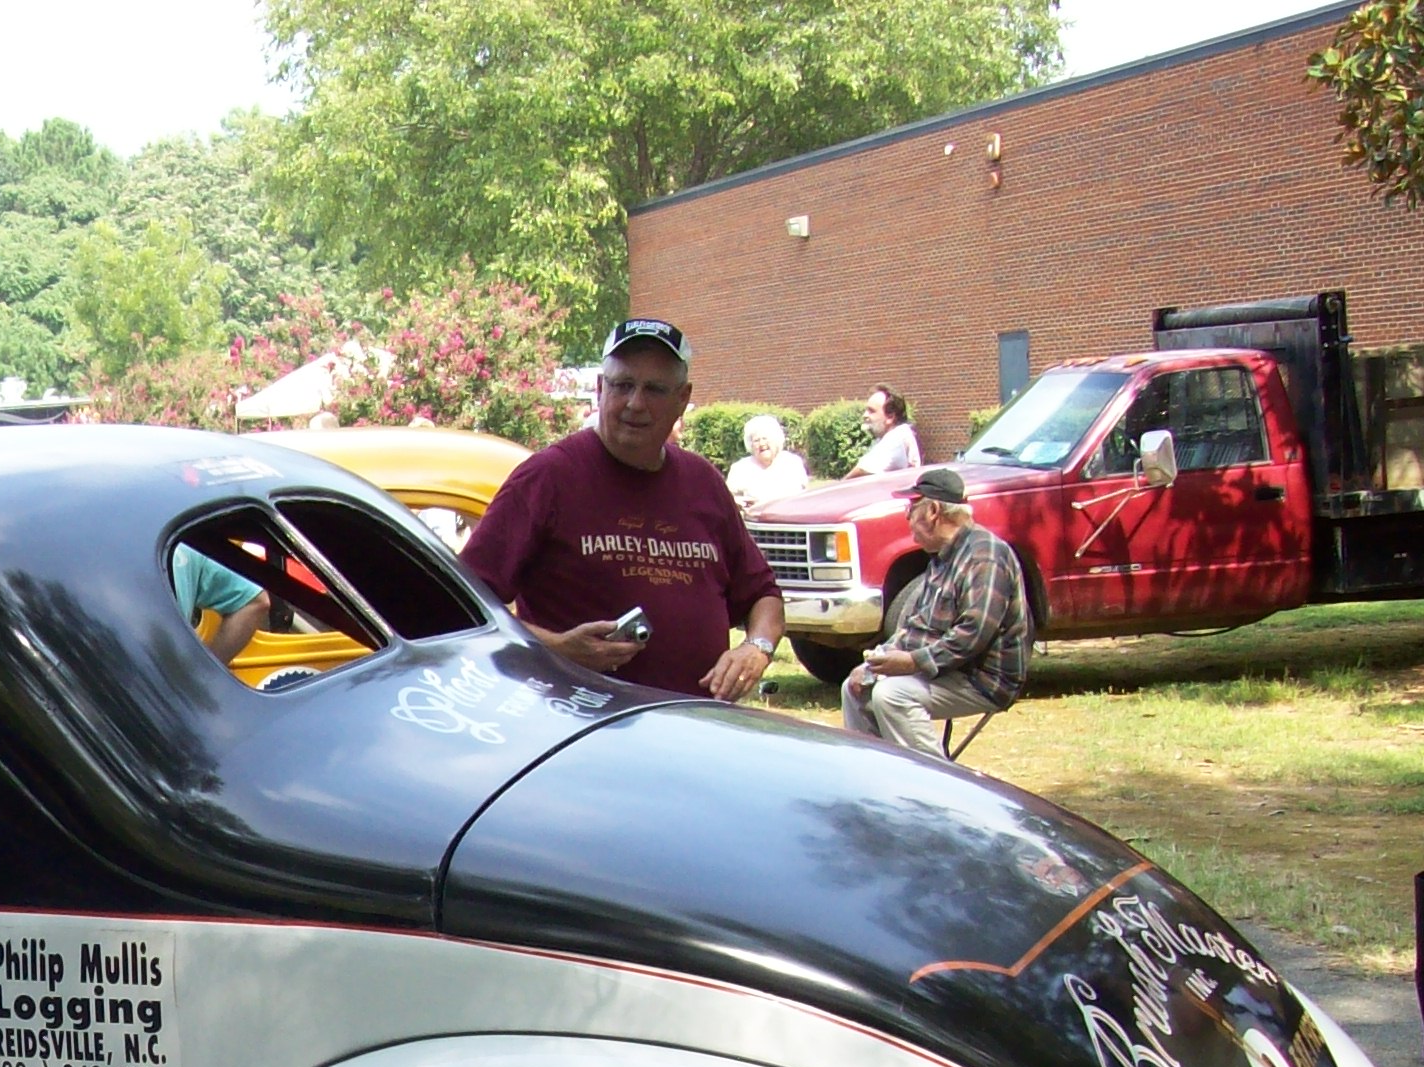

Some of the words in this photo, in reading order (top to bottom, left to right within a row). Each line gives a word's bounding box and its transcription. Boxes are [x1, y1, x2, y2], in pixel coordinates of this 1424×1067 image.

[580, 534, 719, 562] HARLEY-DAVIDSON
[602, 554, 707, 568] MOTORCYCLES
[622, 566, 694, 585] LEGENDARY
[1114, 895, 1279, 988] Master
[80, 942, 162, 986] Mullis
[124, 1034, 167, 1064] N.C.
